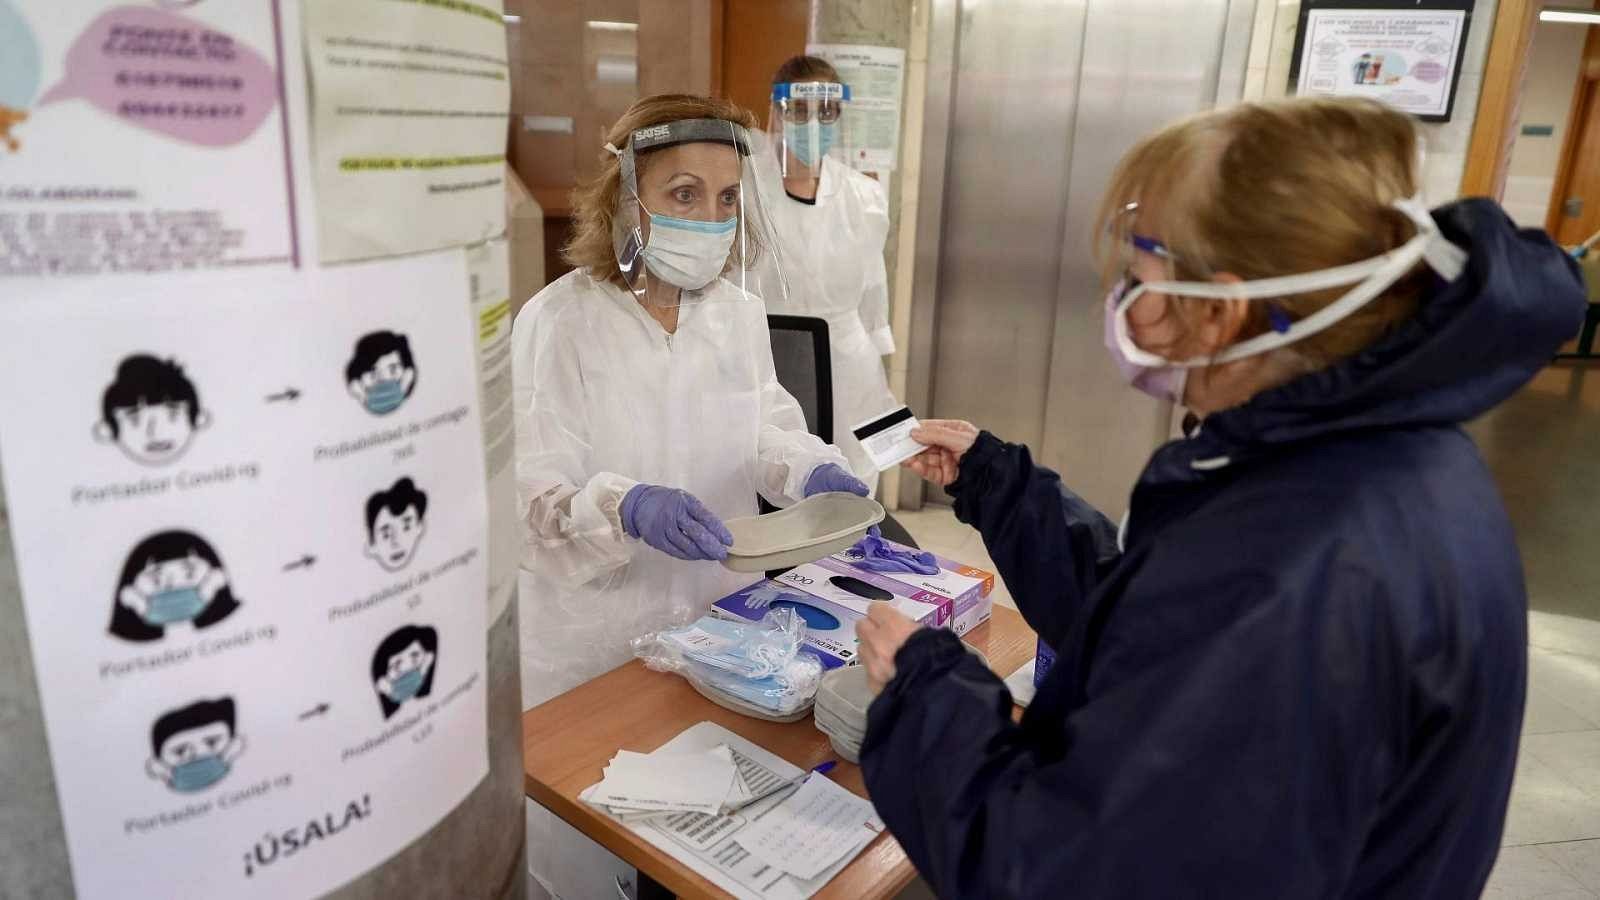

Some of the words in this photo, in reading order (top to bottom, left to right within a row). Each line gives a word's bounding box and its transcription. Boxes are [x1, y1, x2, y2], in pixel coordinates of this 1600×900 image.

[634, 124, 670, 140] SATSE
[313, 426, 402, 462] Probabilidad
[403, 421, 421, 436] de
[423, 405, 470, 431] contagio
[71, 475, 170, 506] Portador
[328, 577, 413, 621] Probabilidad
[415, 571, 431, 585] de
[432, 547, 479, 576] contagio
[99, 646, 193, 679] Portador
[341, 709, 423, 762] Probabilidad
[124, 802, 212, 835] Portador
[243, 793, 371, 877] ¡ÚSALA!
